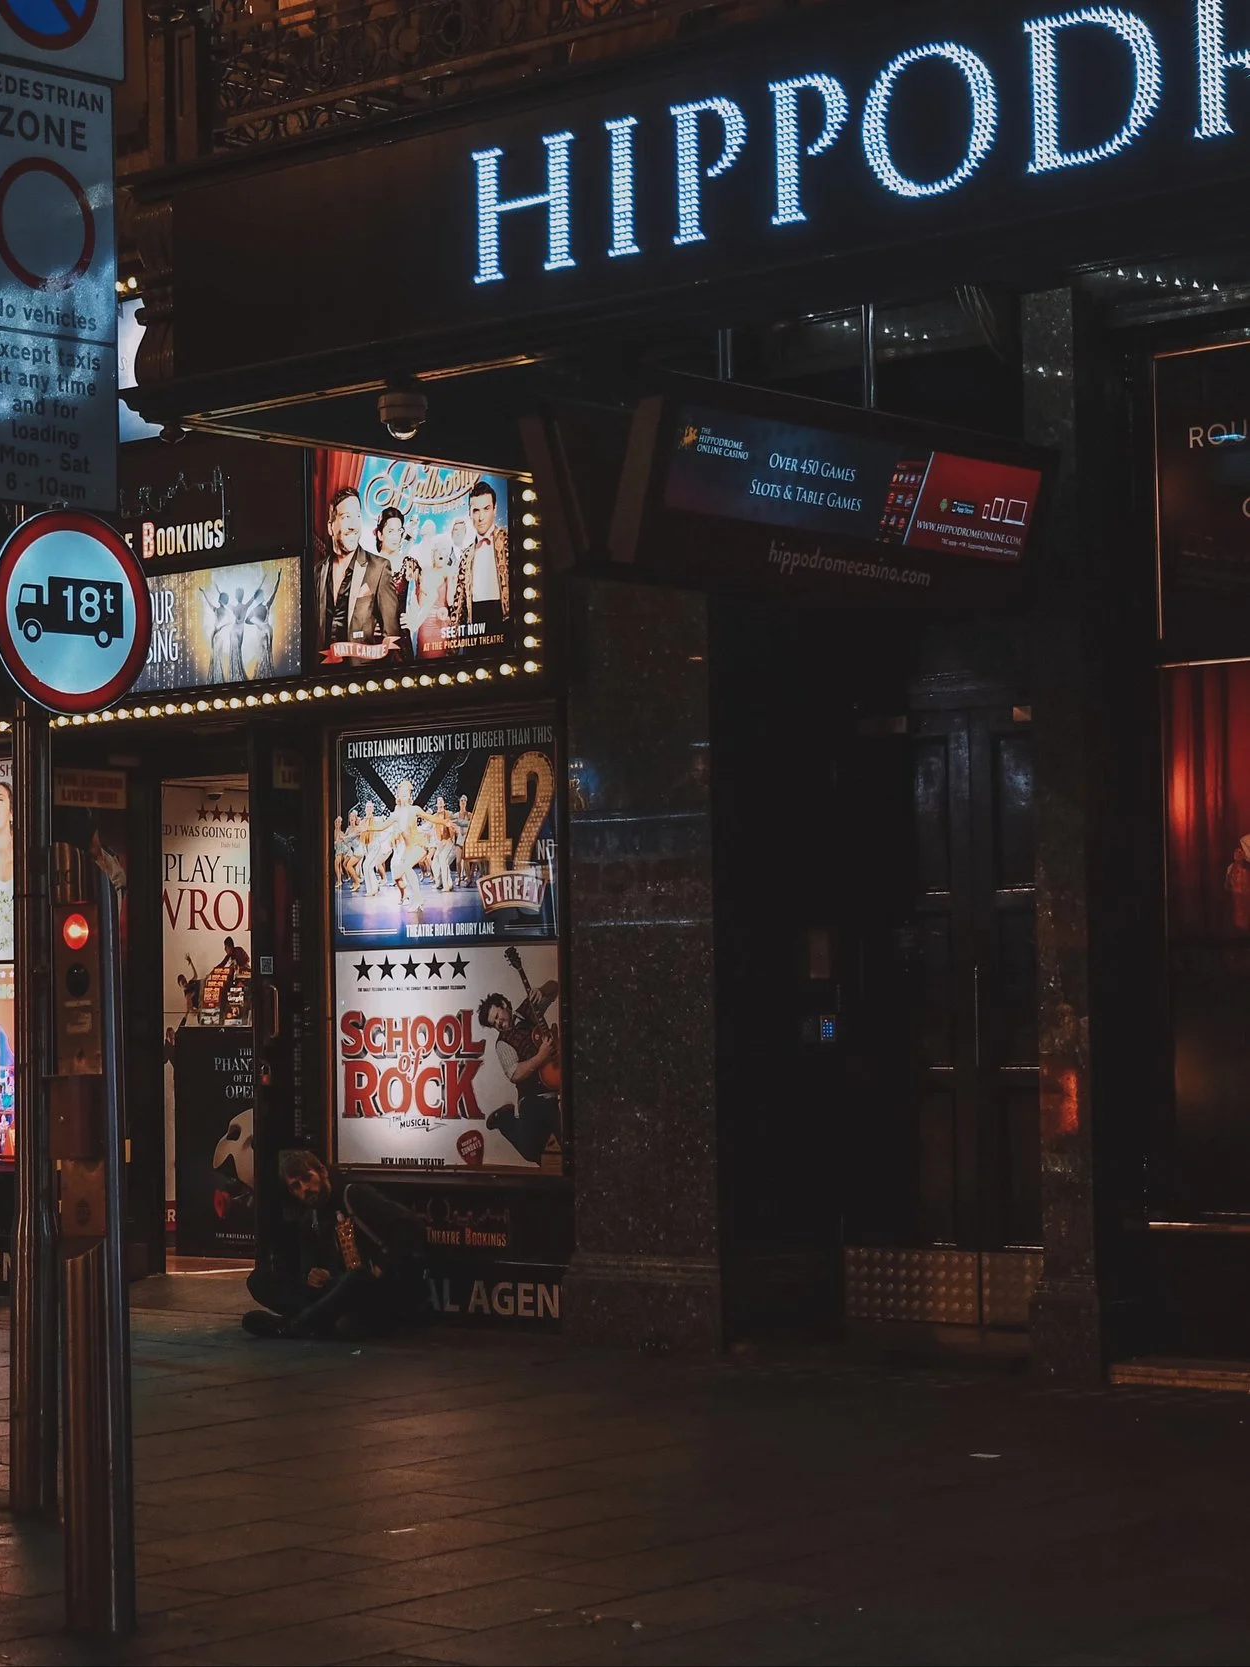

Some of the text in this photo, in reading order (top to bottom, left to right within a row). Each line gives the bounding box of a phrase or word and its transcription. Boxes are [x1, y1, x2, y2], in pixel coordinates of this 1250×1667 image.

[23, 306, 97, 332] vehicles
[58, 347, 101, 371] taxis
[18, 373, 51, 394] any
[56, 373, 97, 396] time
[11, 397, 79, 420] and for
[11, 419, 80, 449] loading
[699, 435, 744, 450] HIPPODROME
[700, 427, 712, 435] THE
[0, 445, 91, 474] Mon Sat
[697, 445, 749, 461] ONLINE CASINO
[799, 459, 819, 476] 450
[6, 472, 86, 500] 6 10am
[783, 485, 793, 501] &
[768, 539, 931, 586] hippodromecasino.com
[62, 585, 115, 624] 18t
[440, 622, 486, 638] SEE IT NOW
[334, 643, 355, 658] MATT
[423, 634, 504, 652] AT THE PICCADILLY THEATRE
[347, 725, 553, 760] ENTERTAINMENT DOESN'T GET BIGGER THAN THIS
[464, 751, 555, 878] 42
[178, 825, 200, 838] WAS
[202, 826, 233, 839] GOING
[234, 828, 247, 839] TO
[163, 853, 221, 883] PLAY
[482, 875, 543, 906] STREET
[406, 921, 495, 938] THEATRE ROYAL DRURY LANE
[340, 1009, 487, 1060] SCHOOL
[397, 1046, 426, 1082] of
[341, 1059, 486, 1120] ROCK
[399, 1117, 431, 1129] MUSICAL
[380, 1157, 445, 1167] NEW LONDON THEATRE
[426, 1226, 508, 1248] THEATRE BOOKINGS
